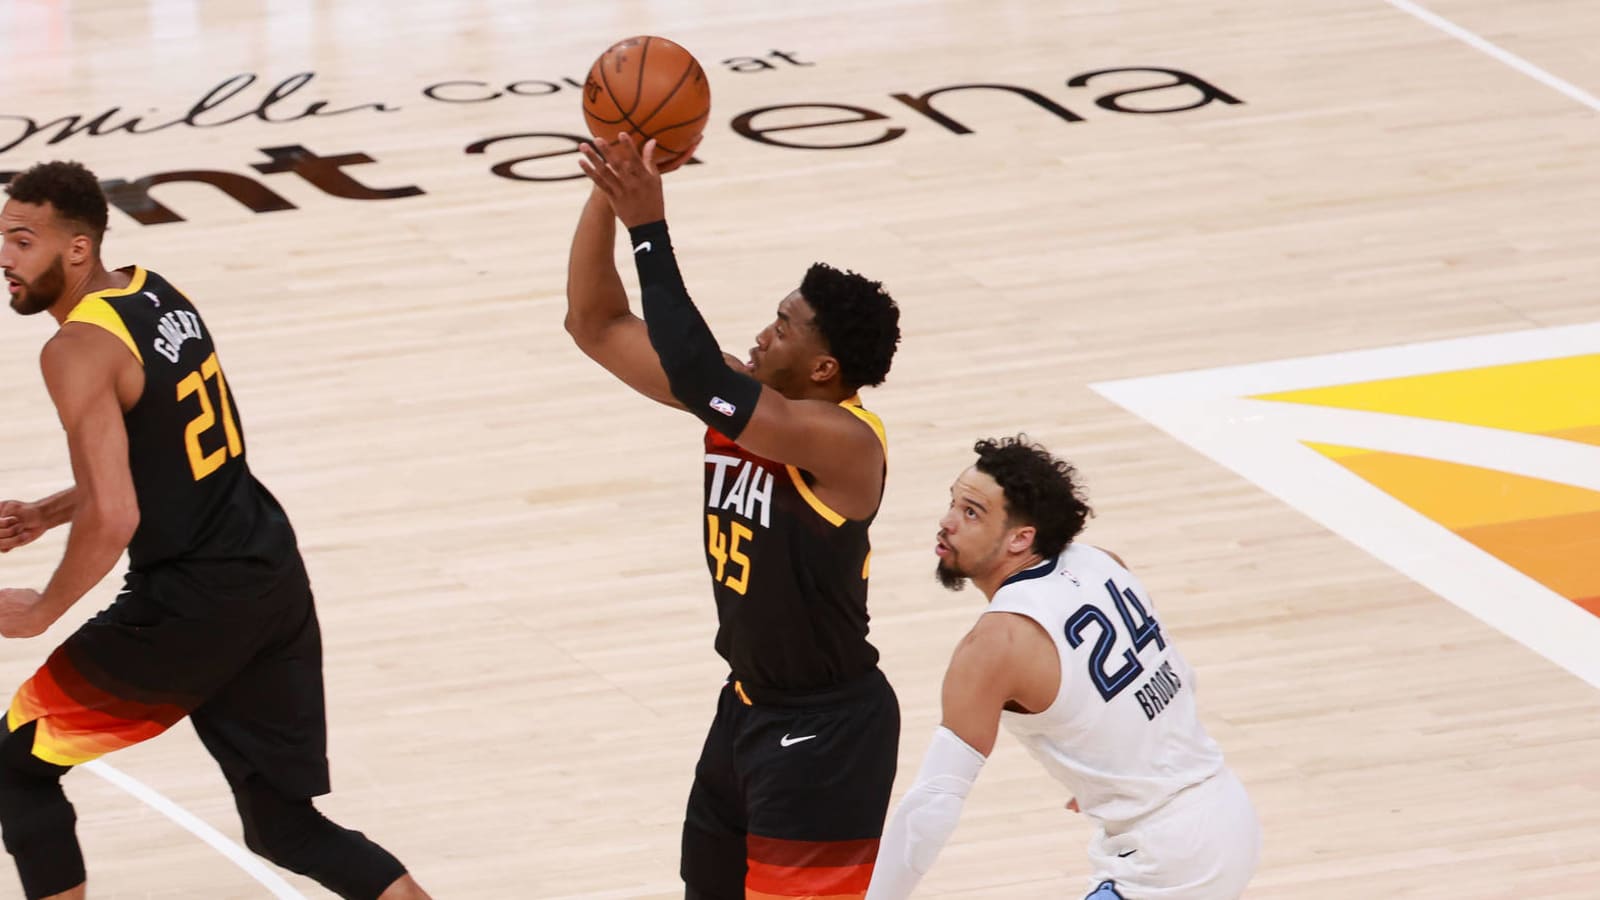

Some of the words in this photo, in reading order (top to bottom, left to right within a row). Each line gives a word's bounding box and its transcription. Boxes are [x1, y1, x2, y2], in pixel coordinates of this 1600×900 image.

[721, 48, 815, 73] at
[176, 352, 243, 481] 27
[704, 453, 774, 528] TAH
[707, 514, 753, 595] 45
[1064, 579, 1166, 702] 24
[1134, 660, 1181, 721] BROOKS
